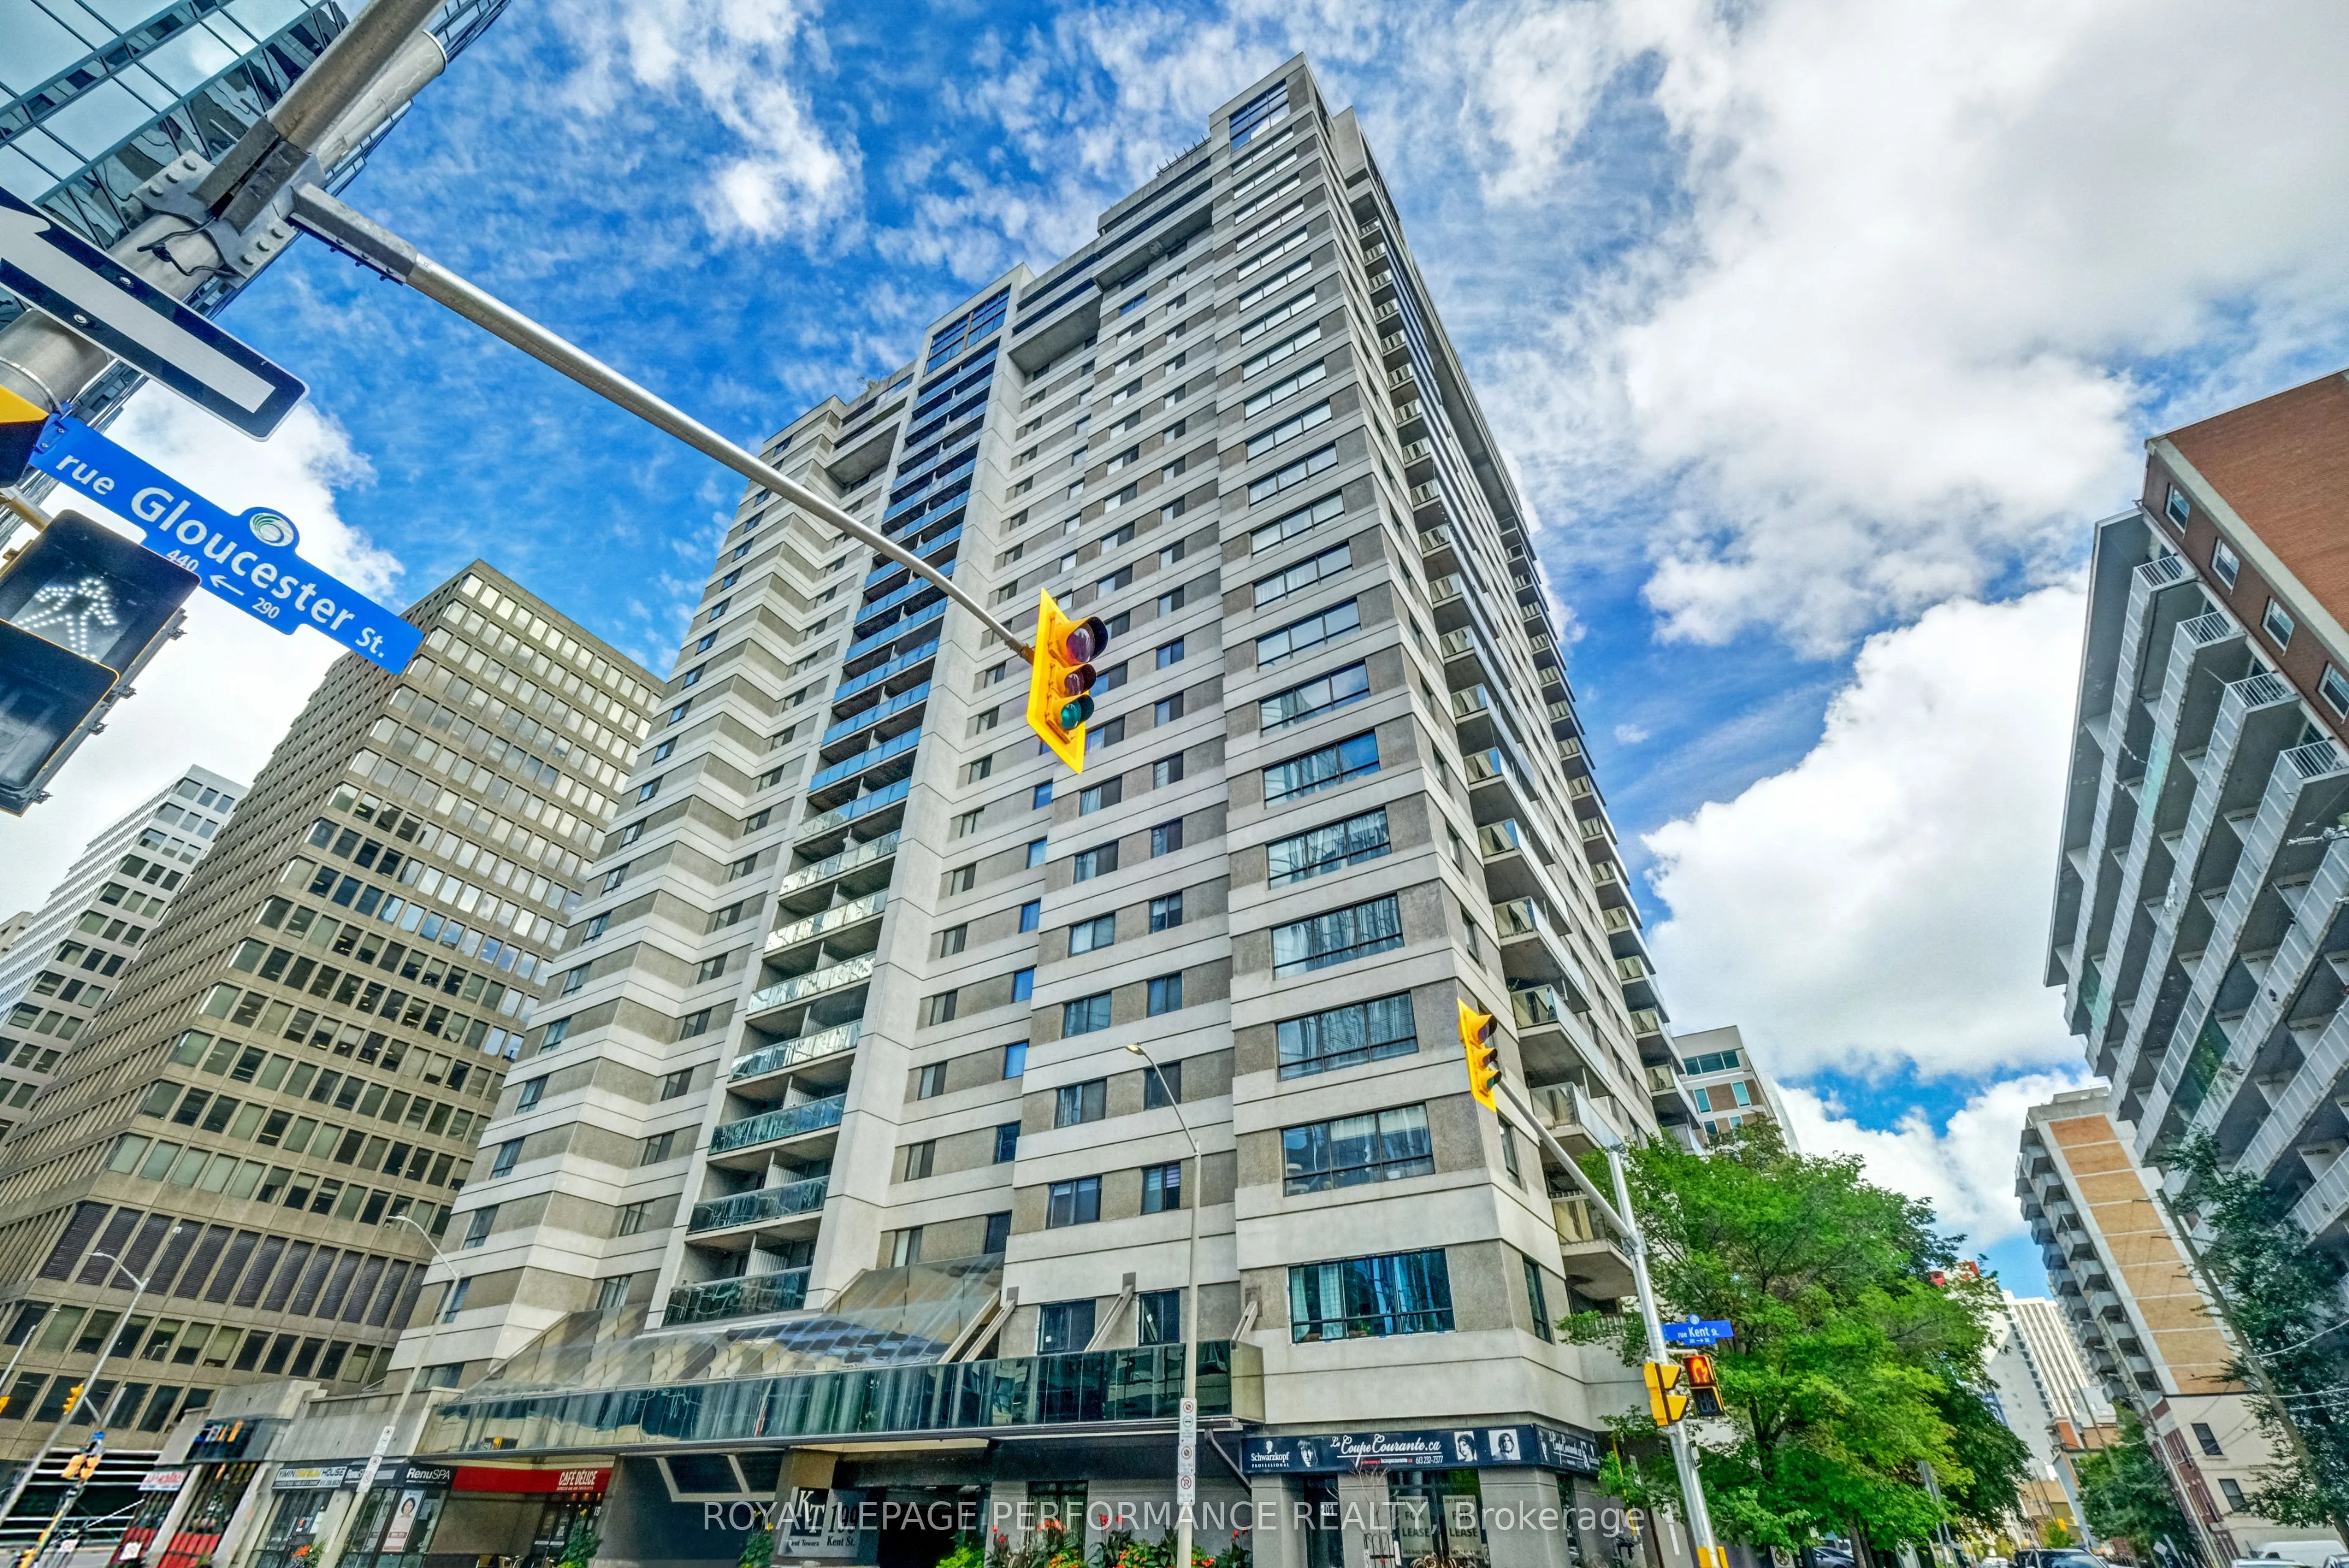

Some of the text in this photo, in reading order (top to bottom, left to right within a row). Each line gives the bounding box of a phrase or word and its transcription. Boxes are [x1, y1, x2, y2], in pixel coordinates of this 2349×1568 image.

[56, 454, 385, 658] rue Gloucester St.
[166, 549, 199, 572] 440
[251, 597, 280, 620] 290
[1688, 1326, 1710, 1337] Kent
[1330, 1436, 1340, 1447] La
[1251, 1452, 1290, 1463] Schwarzkopf
[406, 1468, 450, 1480] RenuSPA
[558, 1469, 577, 1485] CAFÉ
[1320, 1504, 1334, 1516] 201
[1402, 1528, 1430, 1537] LEASE
[1449, 1528, 1478, 1537] LEASE
[827, 1536, 856, 1547] Kent St.
